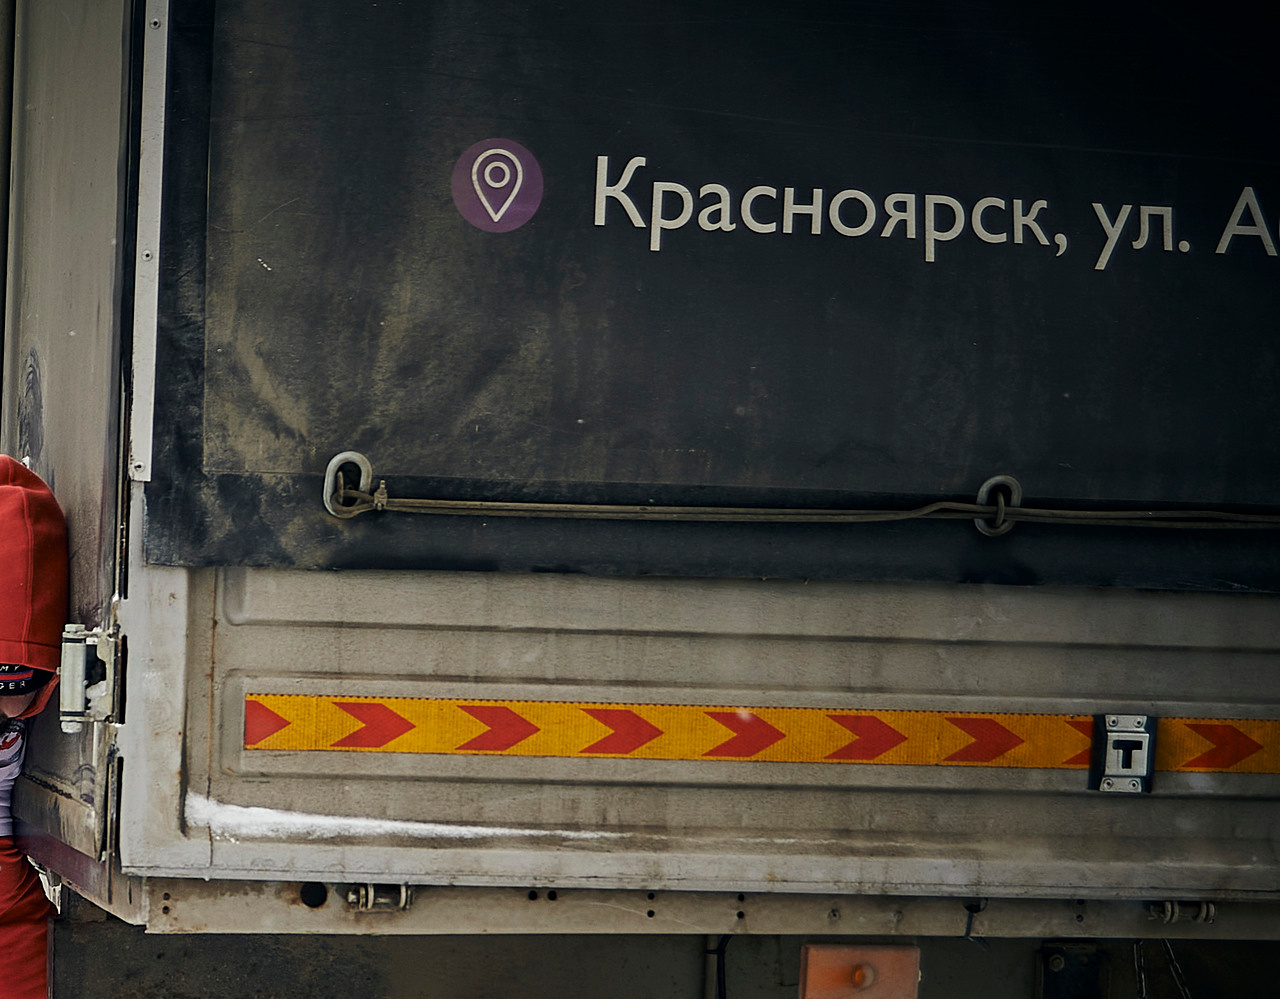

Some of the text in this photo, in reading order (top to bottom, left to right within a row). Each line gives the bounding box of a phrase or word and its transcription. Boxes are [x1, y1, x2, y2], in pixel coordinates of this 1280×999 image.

[593, 155, 1280, 270] Красноярск, ул. А
